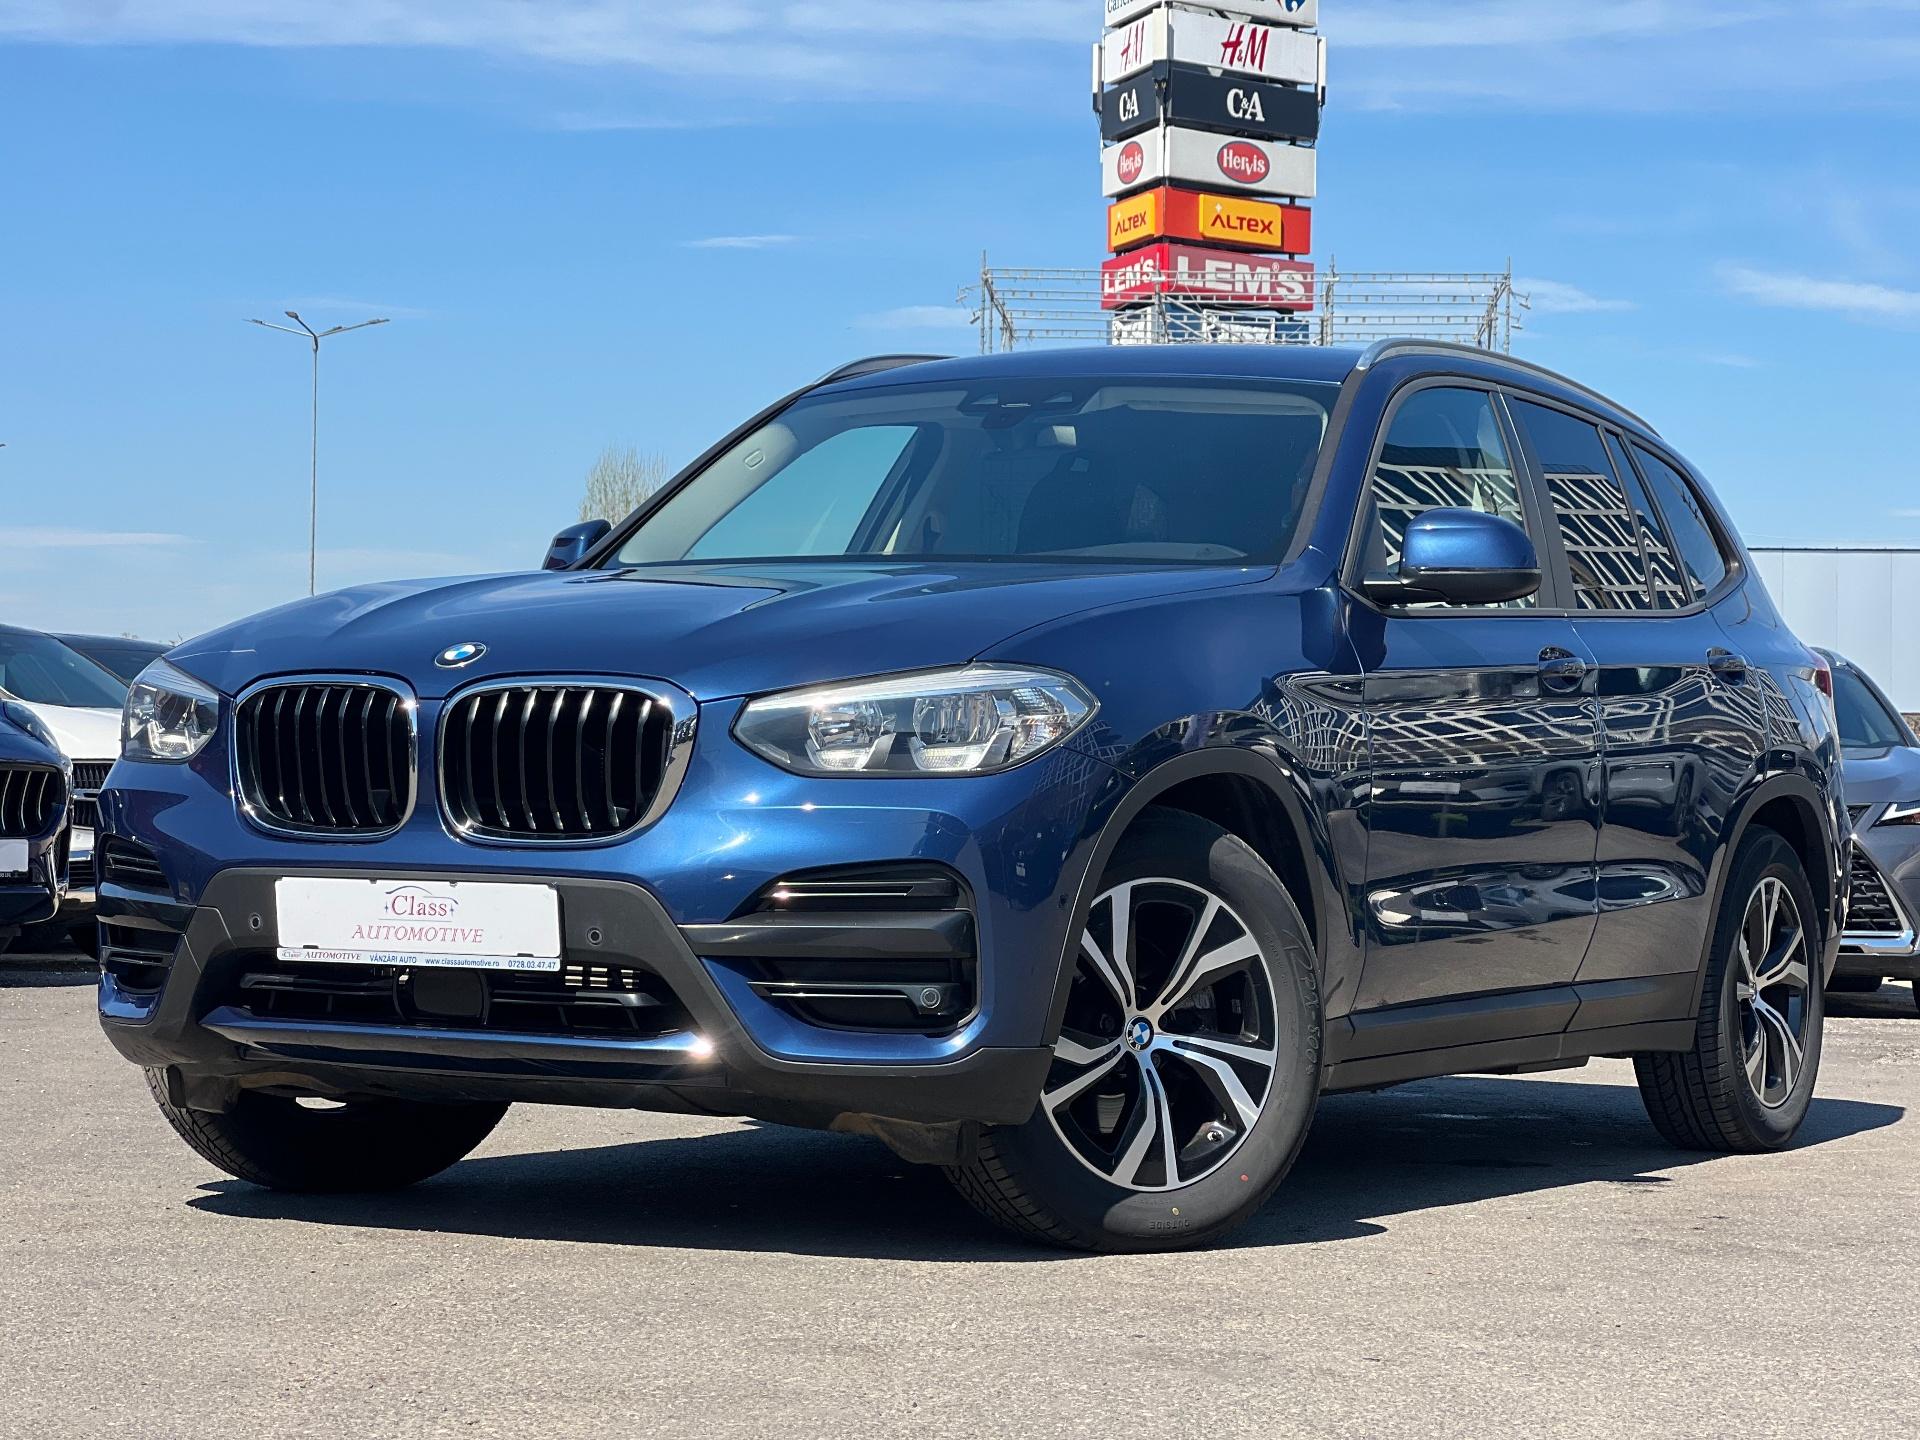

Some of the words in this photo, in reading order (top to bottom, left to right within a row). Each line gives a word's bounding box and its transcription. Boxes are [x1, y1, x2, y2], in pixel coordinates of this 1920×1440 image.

[1220, 23, 1269, 72] H&M
[1119, 88, 1140, 122] C&A
[1226, 88, 1265, 122] C&A
[1120, 151, 1142, 174] Hervis
[1223, 148, 1266, 176] Hervis
[391, 894, 448, 917] Class
[351, 924, 484, 943] AUTOMOTIVE
[304, 951, 361, 960] AUTOMOTIVE
[399, 956, 417, 964] AUTO
[425, 958, 500, 967] www.classautomotive.ro
[508, 961, 556, 970] 0728.03.47.47
